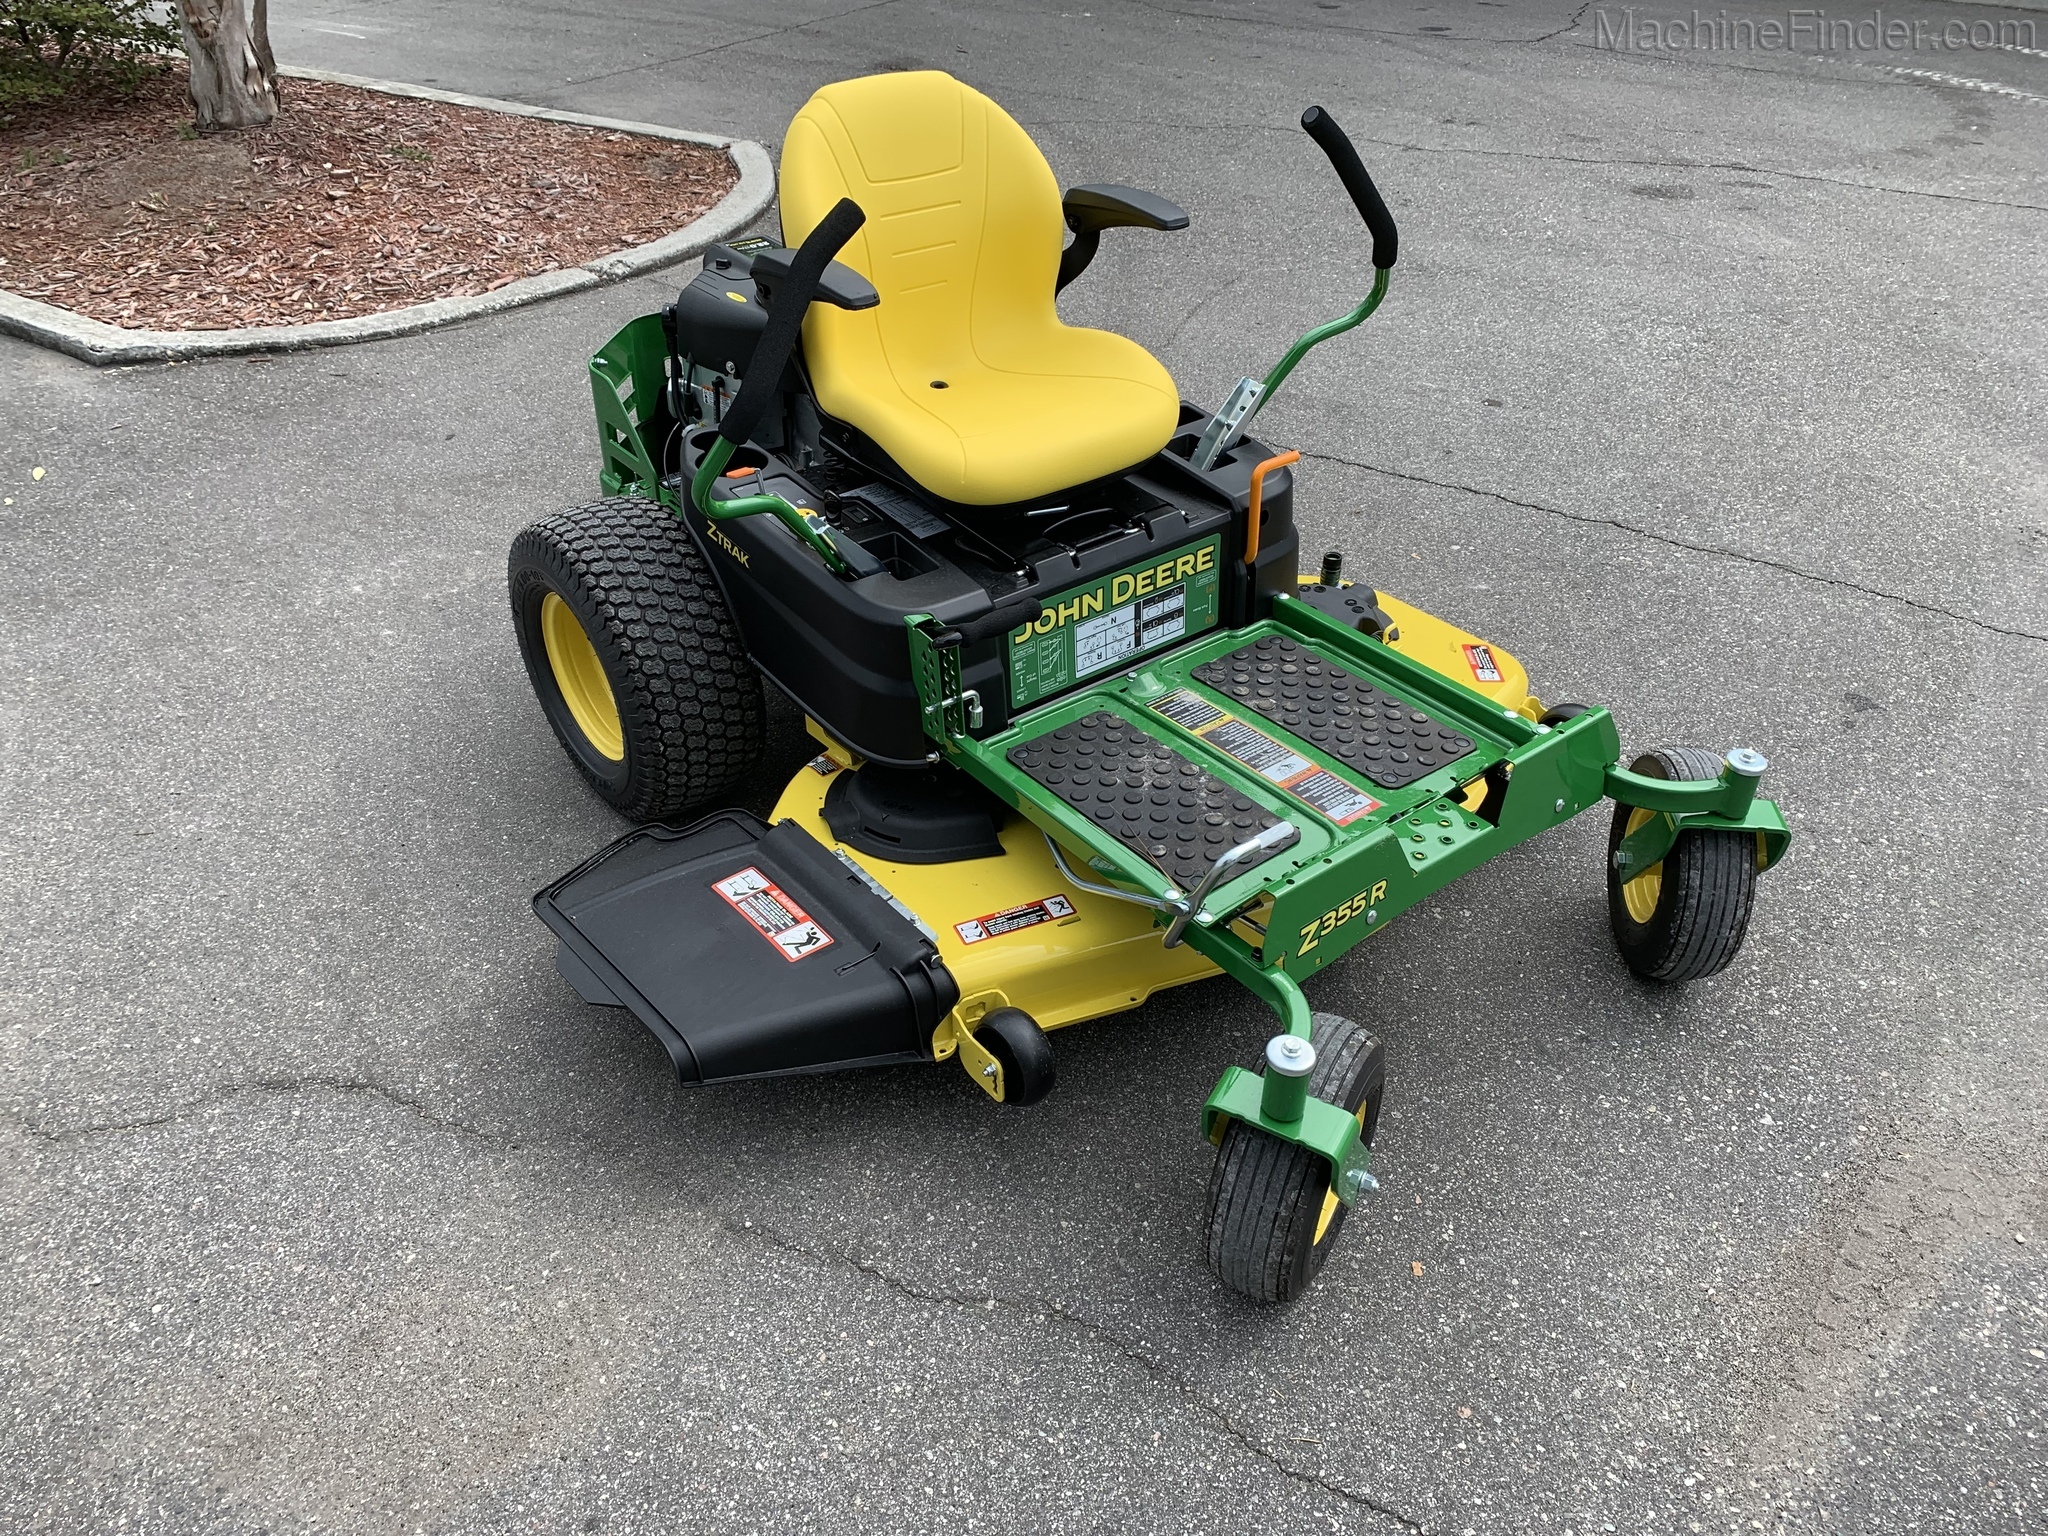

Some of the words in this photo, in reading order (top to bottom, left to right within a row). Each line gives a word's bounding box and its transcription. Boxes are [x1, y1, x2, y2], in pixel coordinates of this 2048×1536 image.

[706, 519, 750, 569] ZTRAK
[1015, 588, 1103, 644] JOHN
[1111, 545, 1215, 607] DEERE
[1118, 645, 1146, 660] OPERATION
[776, 894, 806, 918] DANGER
[999, 904, 1028, 916] DANGER
